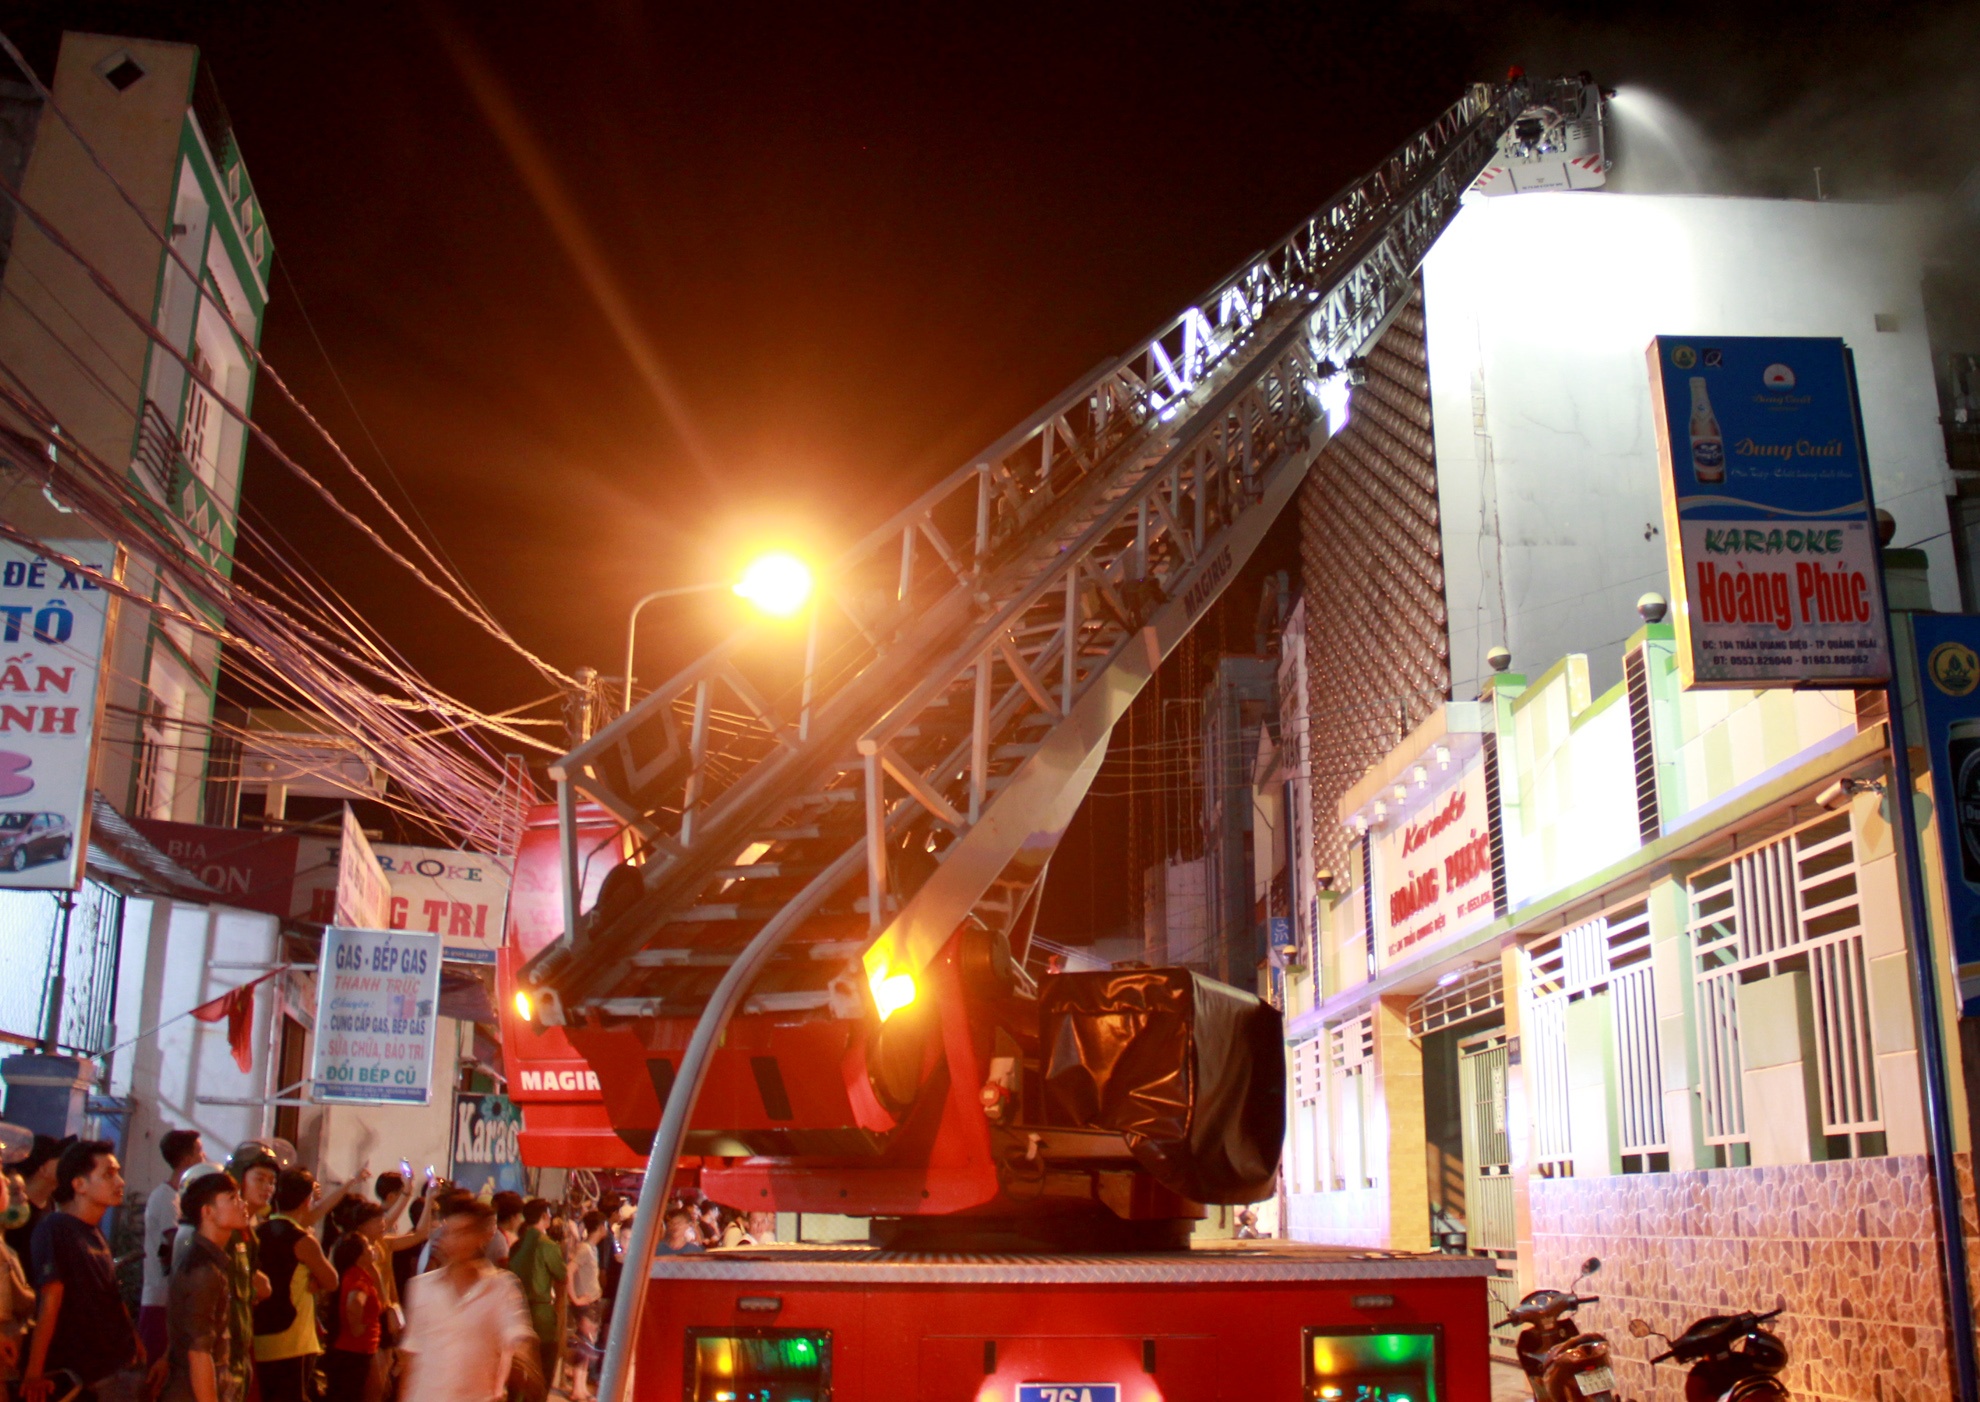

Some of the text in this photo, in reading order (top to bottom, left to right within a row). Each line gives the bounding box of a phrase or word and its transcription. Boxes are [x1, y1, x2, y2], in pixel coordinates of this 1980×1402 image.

[1735, 438, 1792, 461] Dung
[1796, 438, 1842, 457] Quất
[1705, 528, 1843, 555] KARAOKE
[1184, 545, 1233, 620] MAGIRUS
[1697, 561, 1870, 631] Hoàng Phúc
[0, 599, 74, 644] TÔ
[168, 840, 207, 859] BIA
[1390, 868, 1439, 927] HOÀNG
[1444, 828, 1491, 893] PHÚC
[336, 944, 362, 971] GAS
[372, 936, 398, 971] BẾP
[401, 948, 427, 974] GAS
[334, 975, 380, 991] THANH
[330, 1015, 352, 1032] CUNG
[409, 1019, 426, 1036] GAS
[359, 1061, 390, 1083] BẾP
[394, 1066, 416, 1085] CŨ
